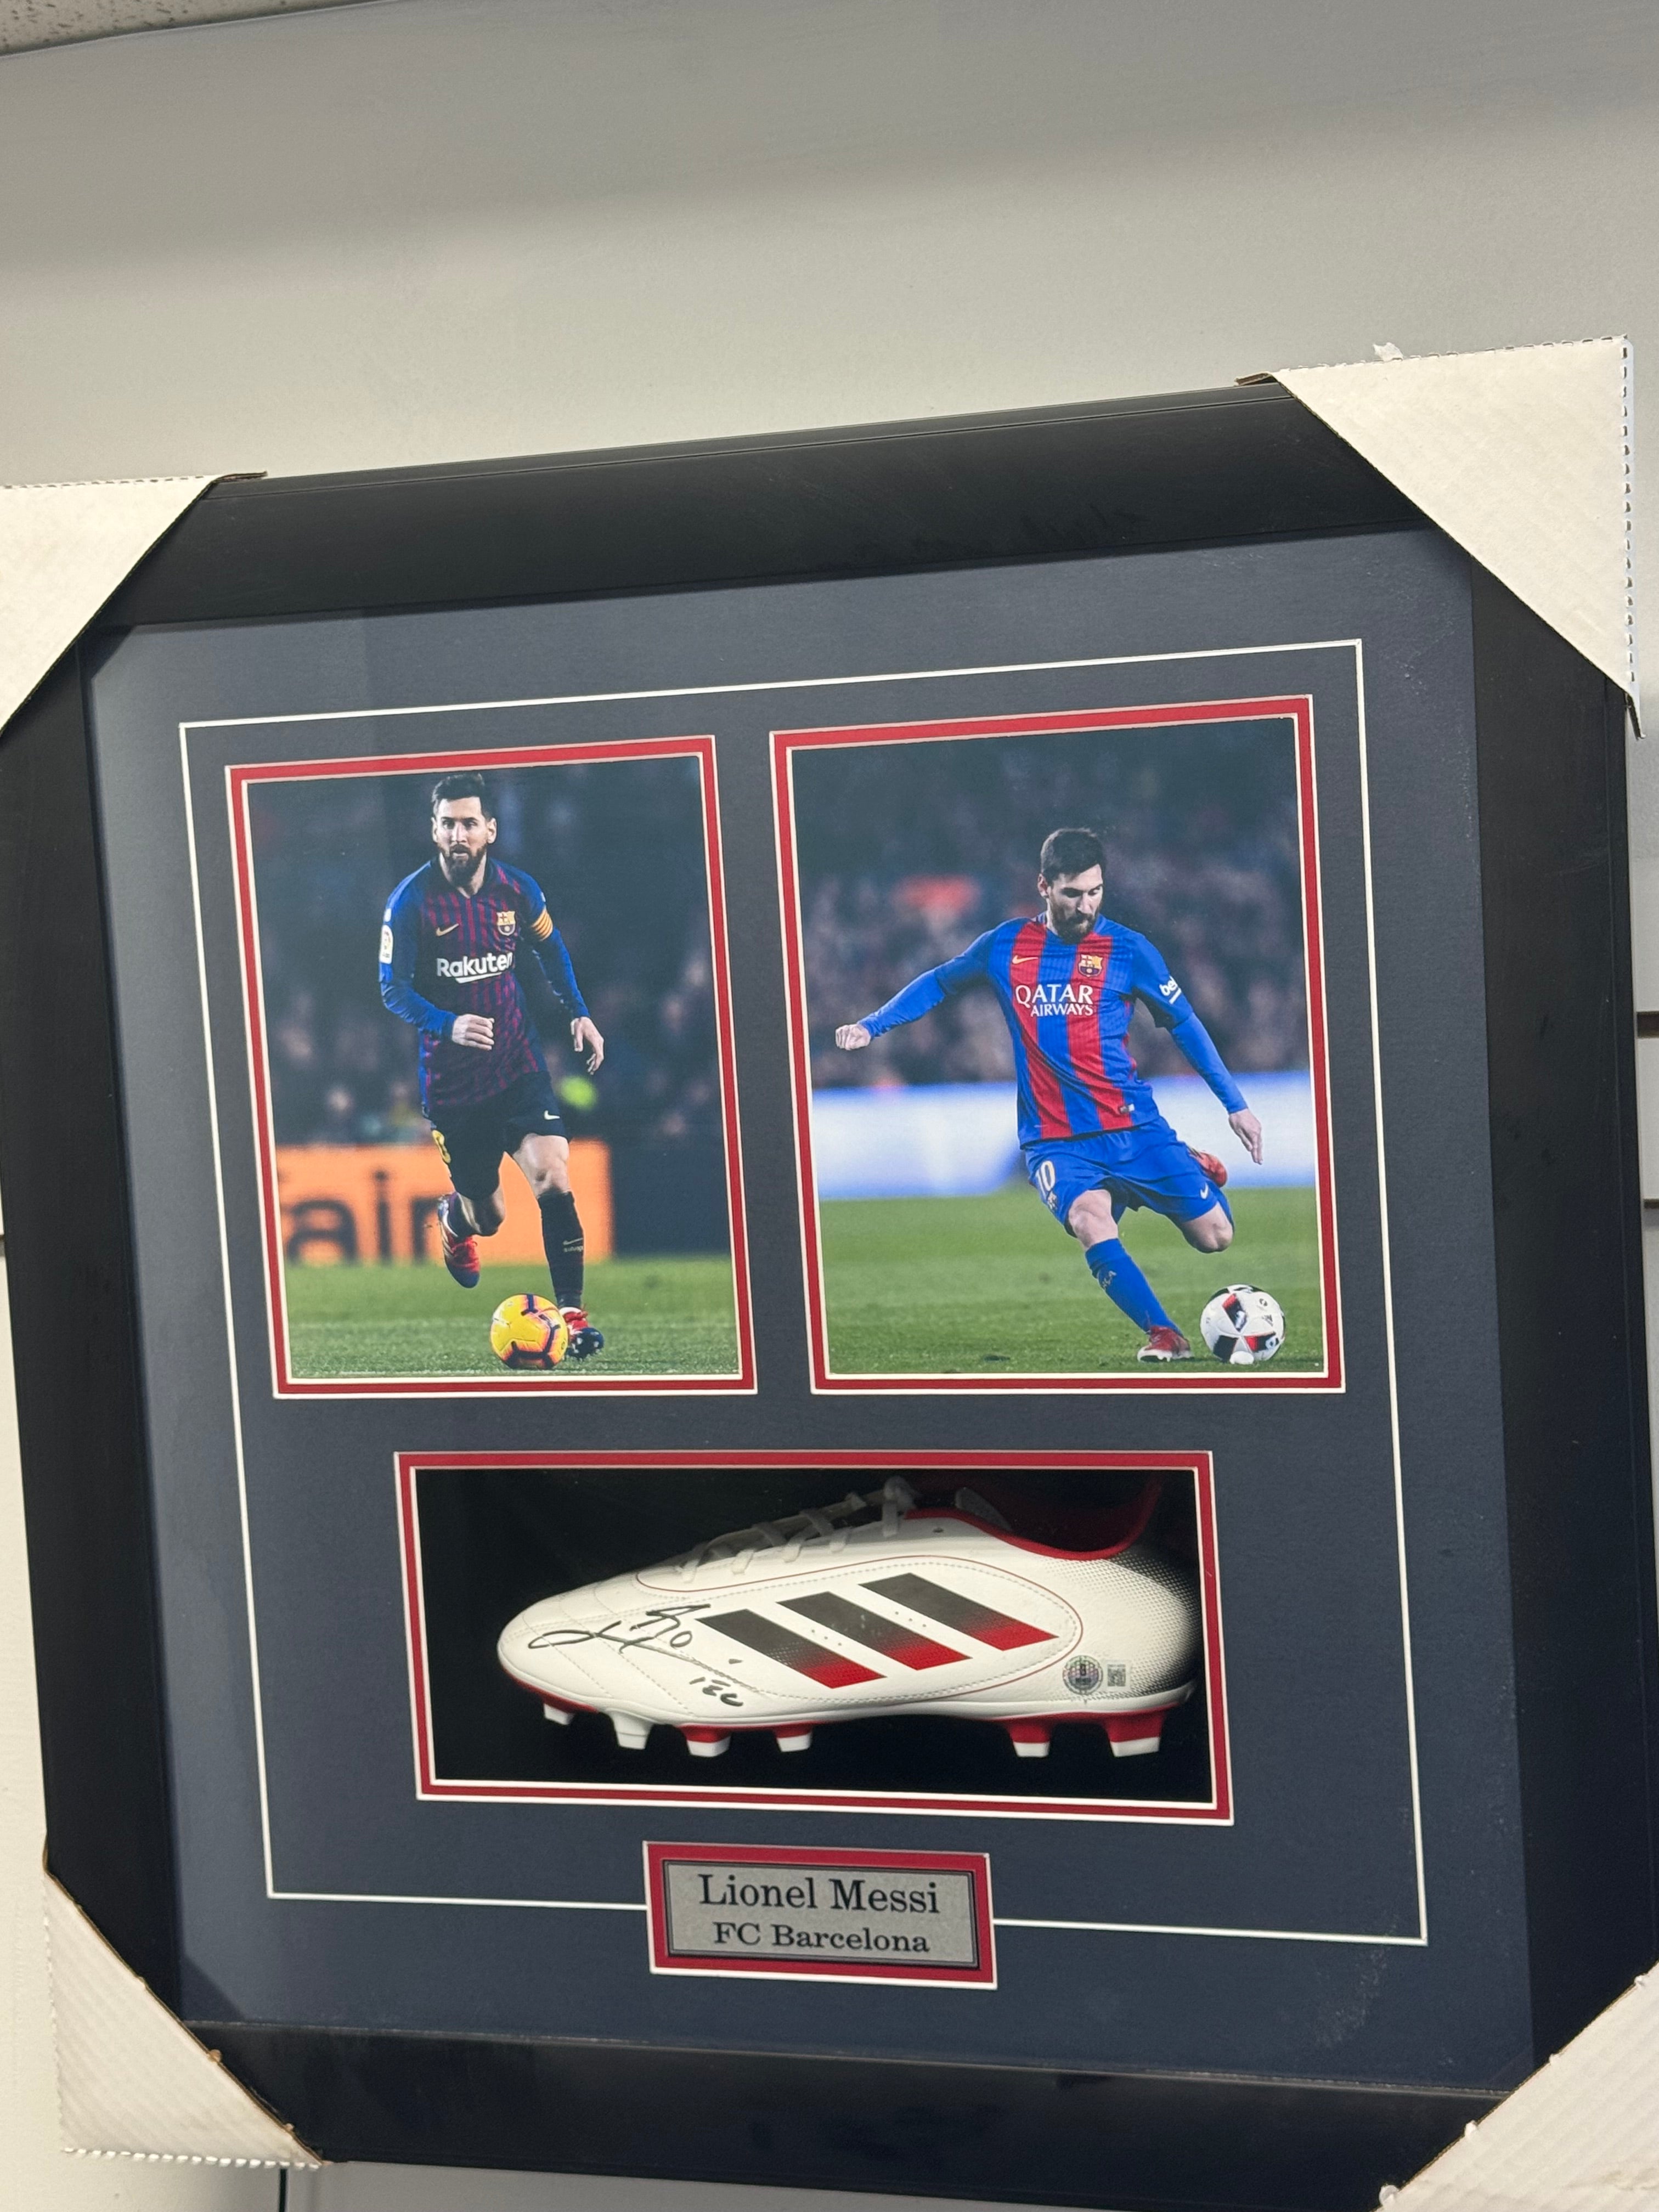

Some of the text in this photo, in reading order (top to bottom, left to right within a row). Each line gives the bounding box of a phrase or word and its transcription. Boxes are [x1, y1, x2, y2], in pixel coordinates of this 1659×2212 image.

[437, 952, 513, 977] Rakuten
[1015, 984, 1093, 1008] QATAR
[1030, 1003, 1093, 1017] AIRWAYS
[1035, 1160, 1056, 1201] 10
[698, 1874, 940, 1914] Lionel Messi
[713, 1922, 930, 1953] FC Barcelona
